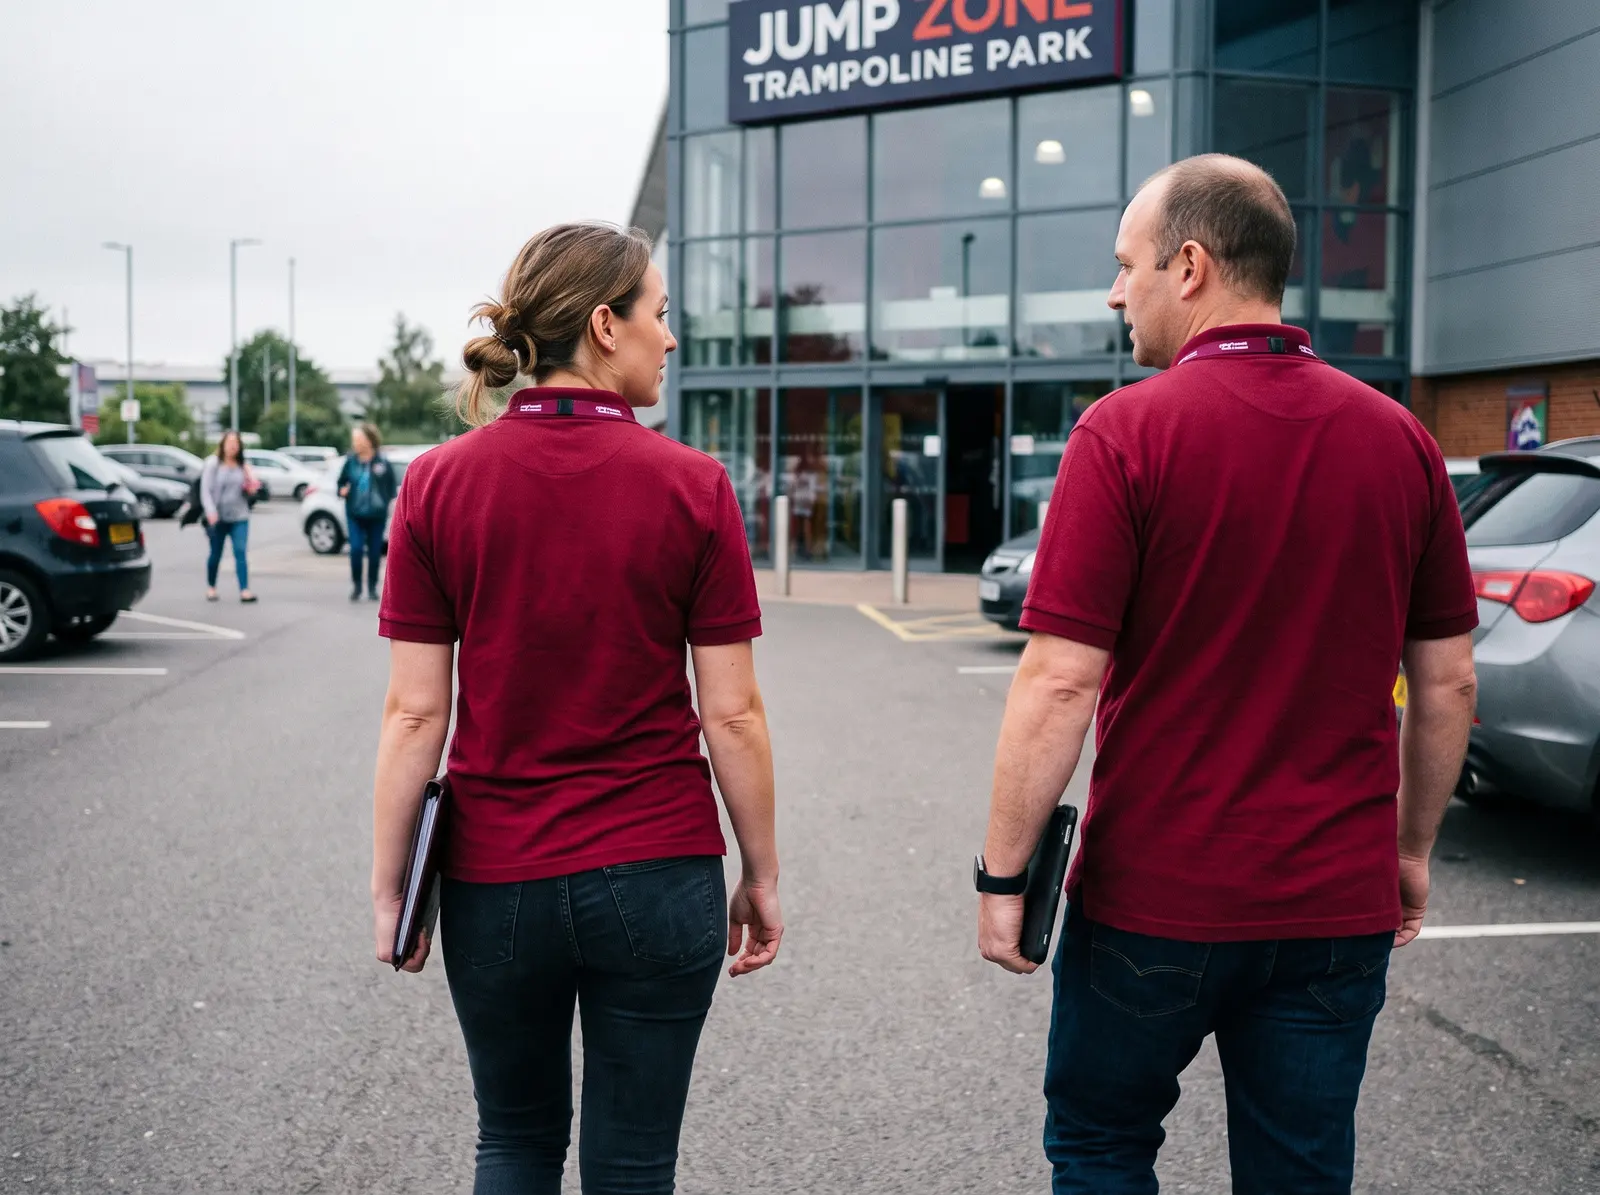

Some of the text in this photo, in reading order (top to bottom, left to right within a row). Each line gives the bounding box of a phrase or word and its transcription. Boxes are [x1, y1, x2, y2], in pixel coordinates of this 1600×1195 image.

[742, 0, 901, 66] JUMP
[743, 26, 1094, 103] TRAMPOLINE PARK
